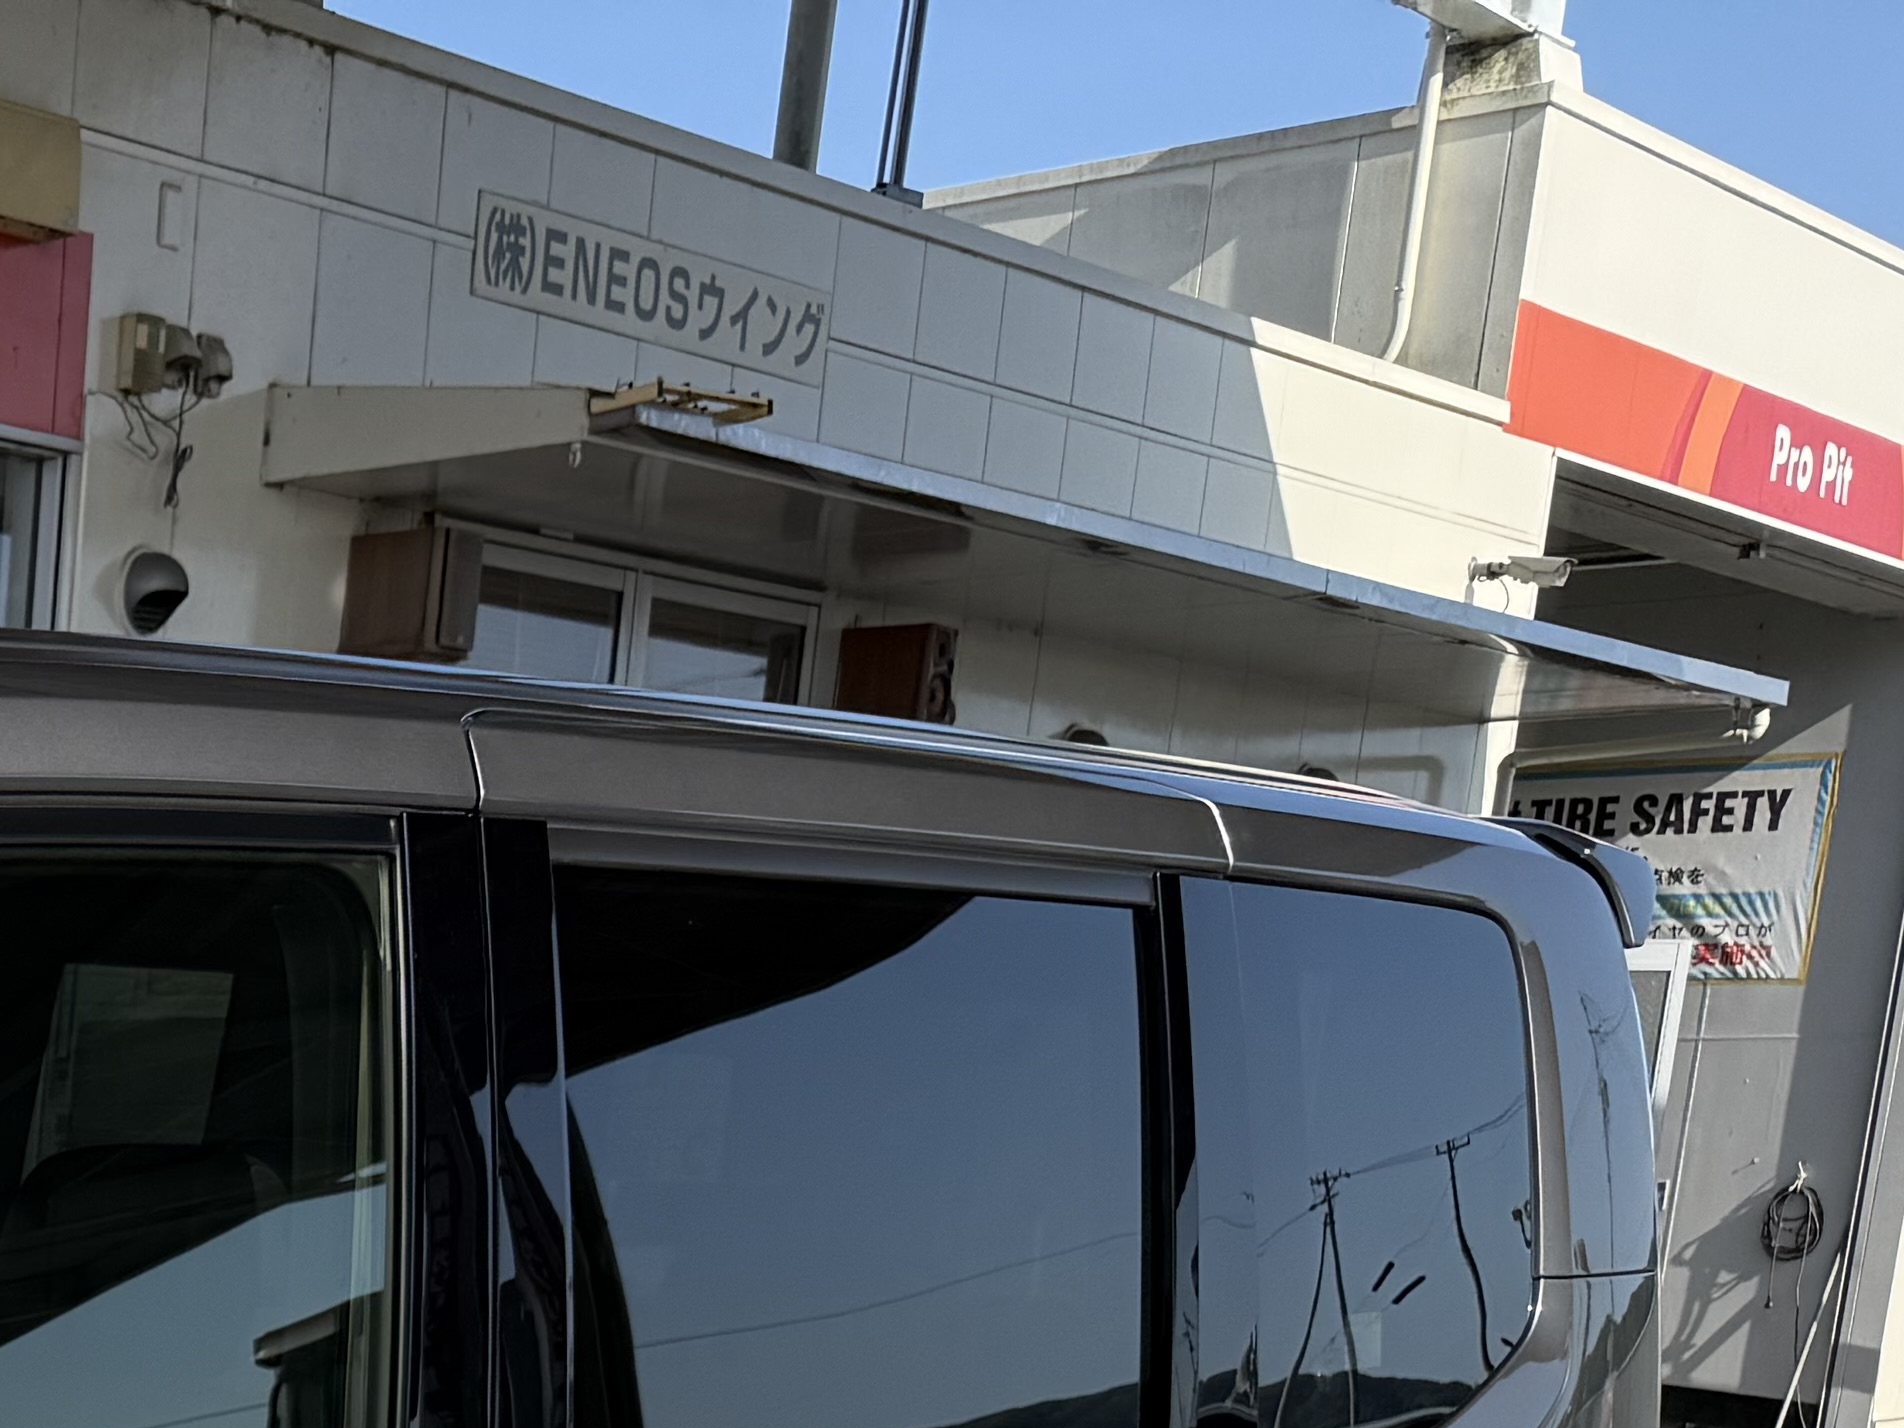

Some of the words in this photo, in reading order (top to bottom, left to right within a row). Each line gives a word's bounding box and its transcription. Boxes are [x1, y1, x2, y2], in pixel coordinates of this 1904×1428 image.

[483, 205, 826, 368] (株)ENEOSウイング
[1769, 423, 1814, 493] Pro
[1819, 441, 1854, 506] Pit
[1531, 795, 1620, 837] TIRE
[1629, 788, 1794, 838] SAFETY
